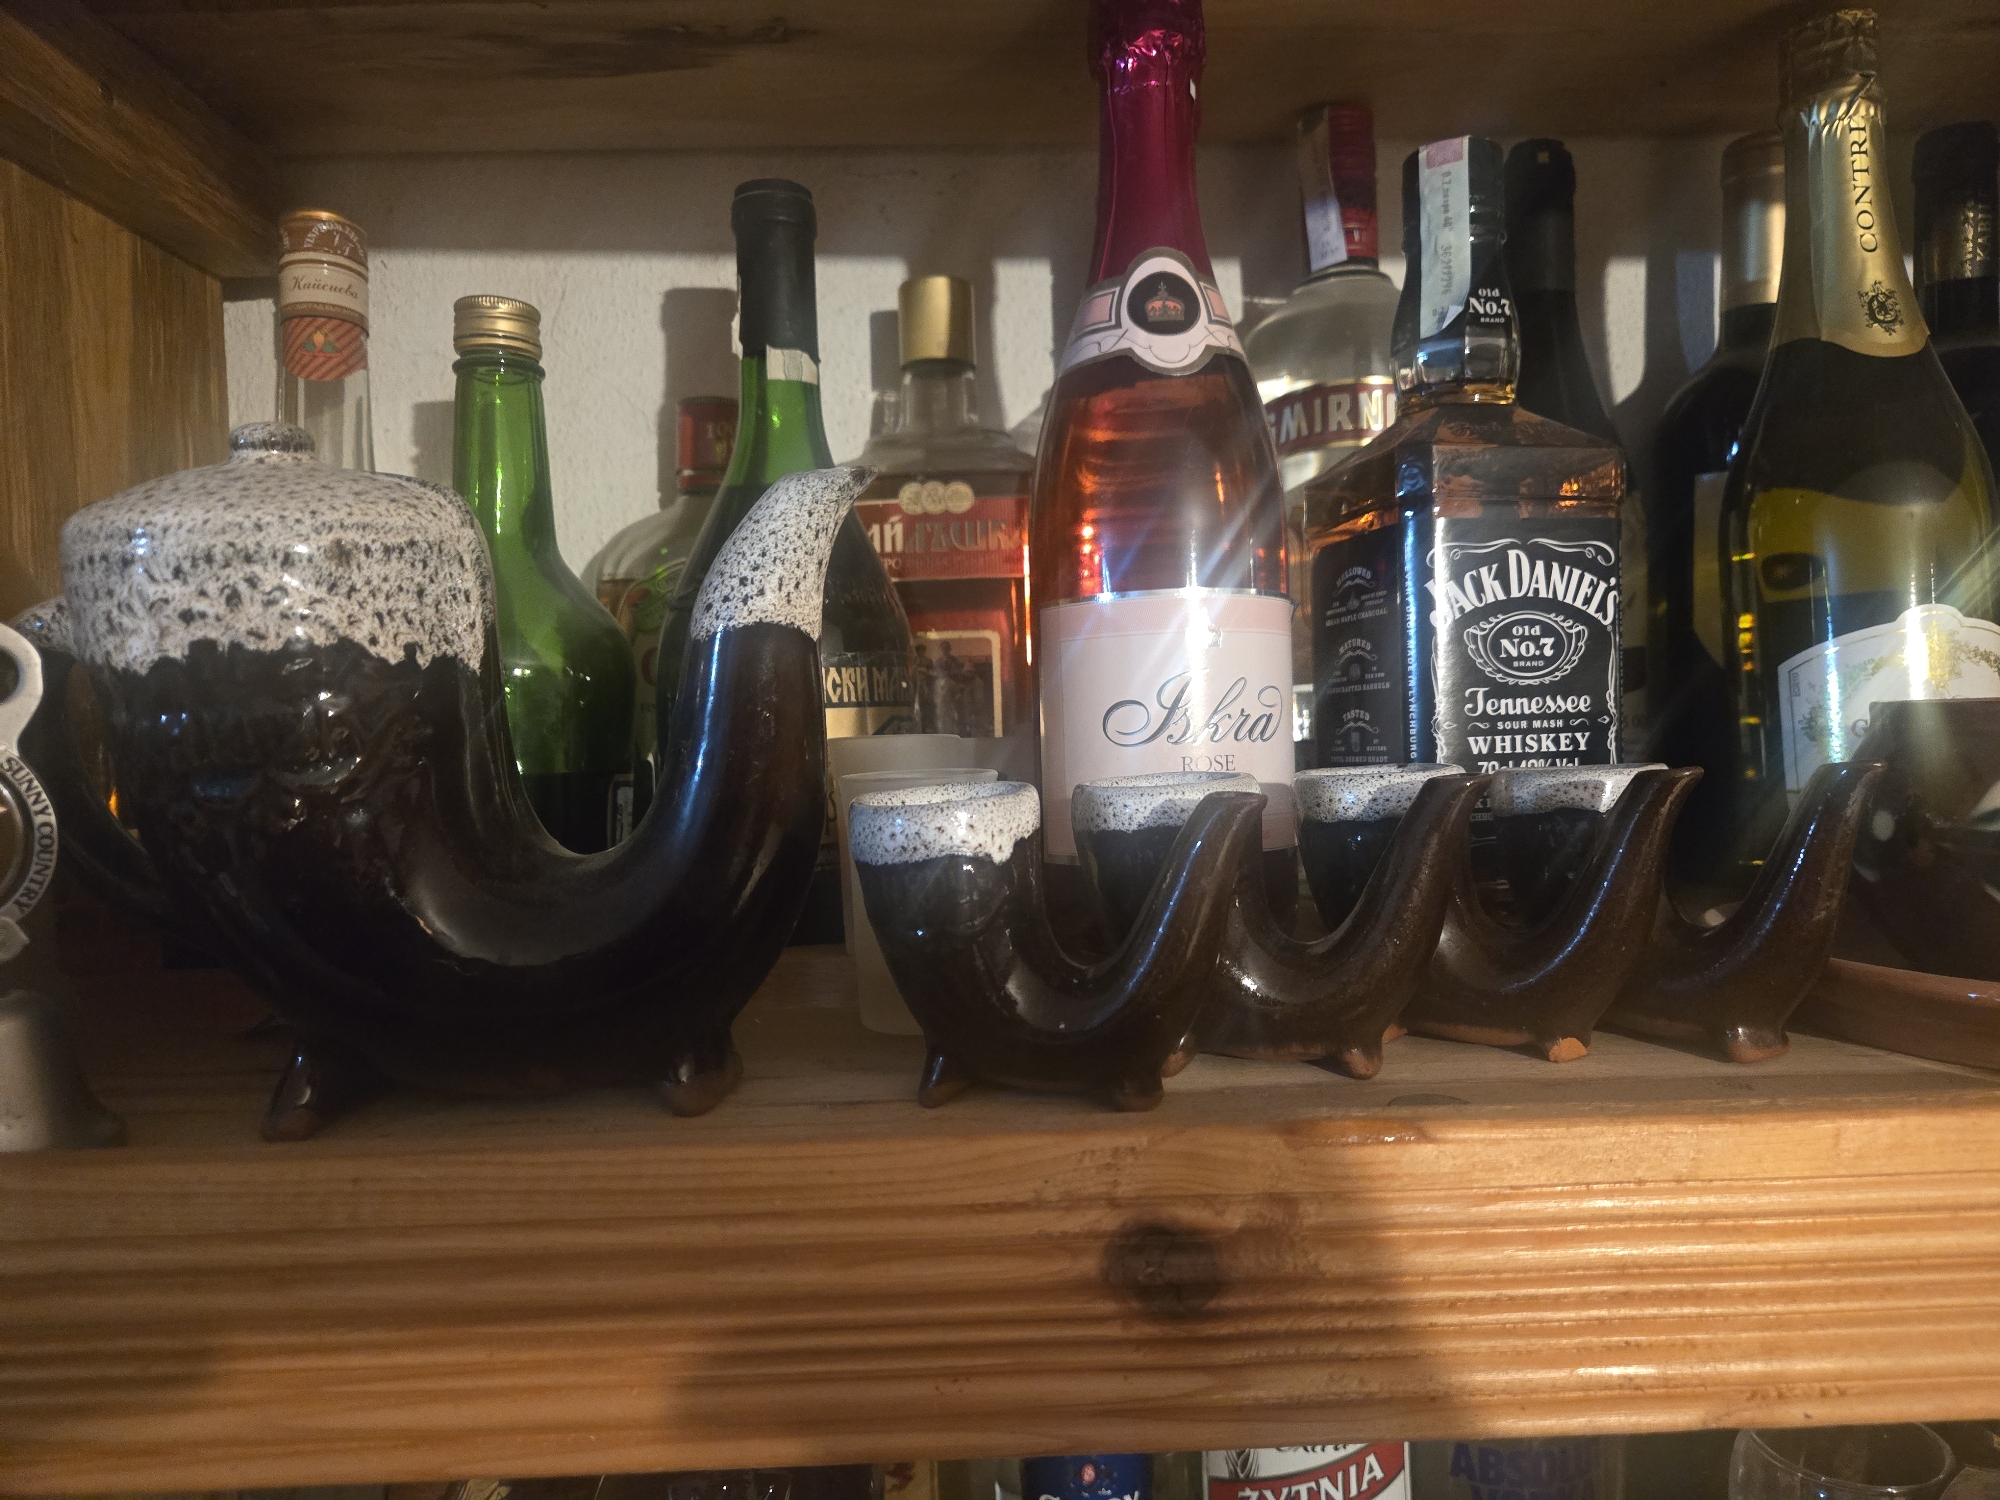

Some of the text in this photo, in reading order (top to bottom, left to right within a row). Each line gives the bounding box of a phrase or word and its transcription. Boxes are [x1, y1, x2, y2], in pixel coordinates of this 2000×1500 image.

[1849, 122, 1878, 253] CONTRI
[1478, 288, 1500, 297] Old
[1468, 297, 1511, 316] No.7
[1424, 549, 1619, 628] JACK DANIEL'S
[1512, 625, 1541, 637] Old
[1407, 640, 1415, 672] MADE
[1499, 637, 1555, 658] No.7
[1102, 668, 1283, 748] Iskra
[1464, 687, 1592, 716] Tennessee
[1408, 690, 1418, 758] LYNCHBURG
[1497, 719, 1563, 730] SOUR MASH
[1467, 731, 1591, 755] WHISKEY
[1181, 754, 1236, 772] ROSE
[1, 756, 56, 915] SUNNY COUNTRY
